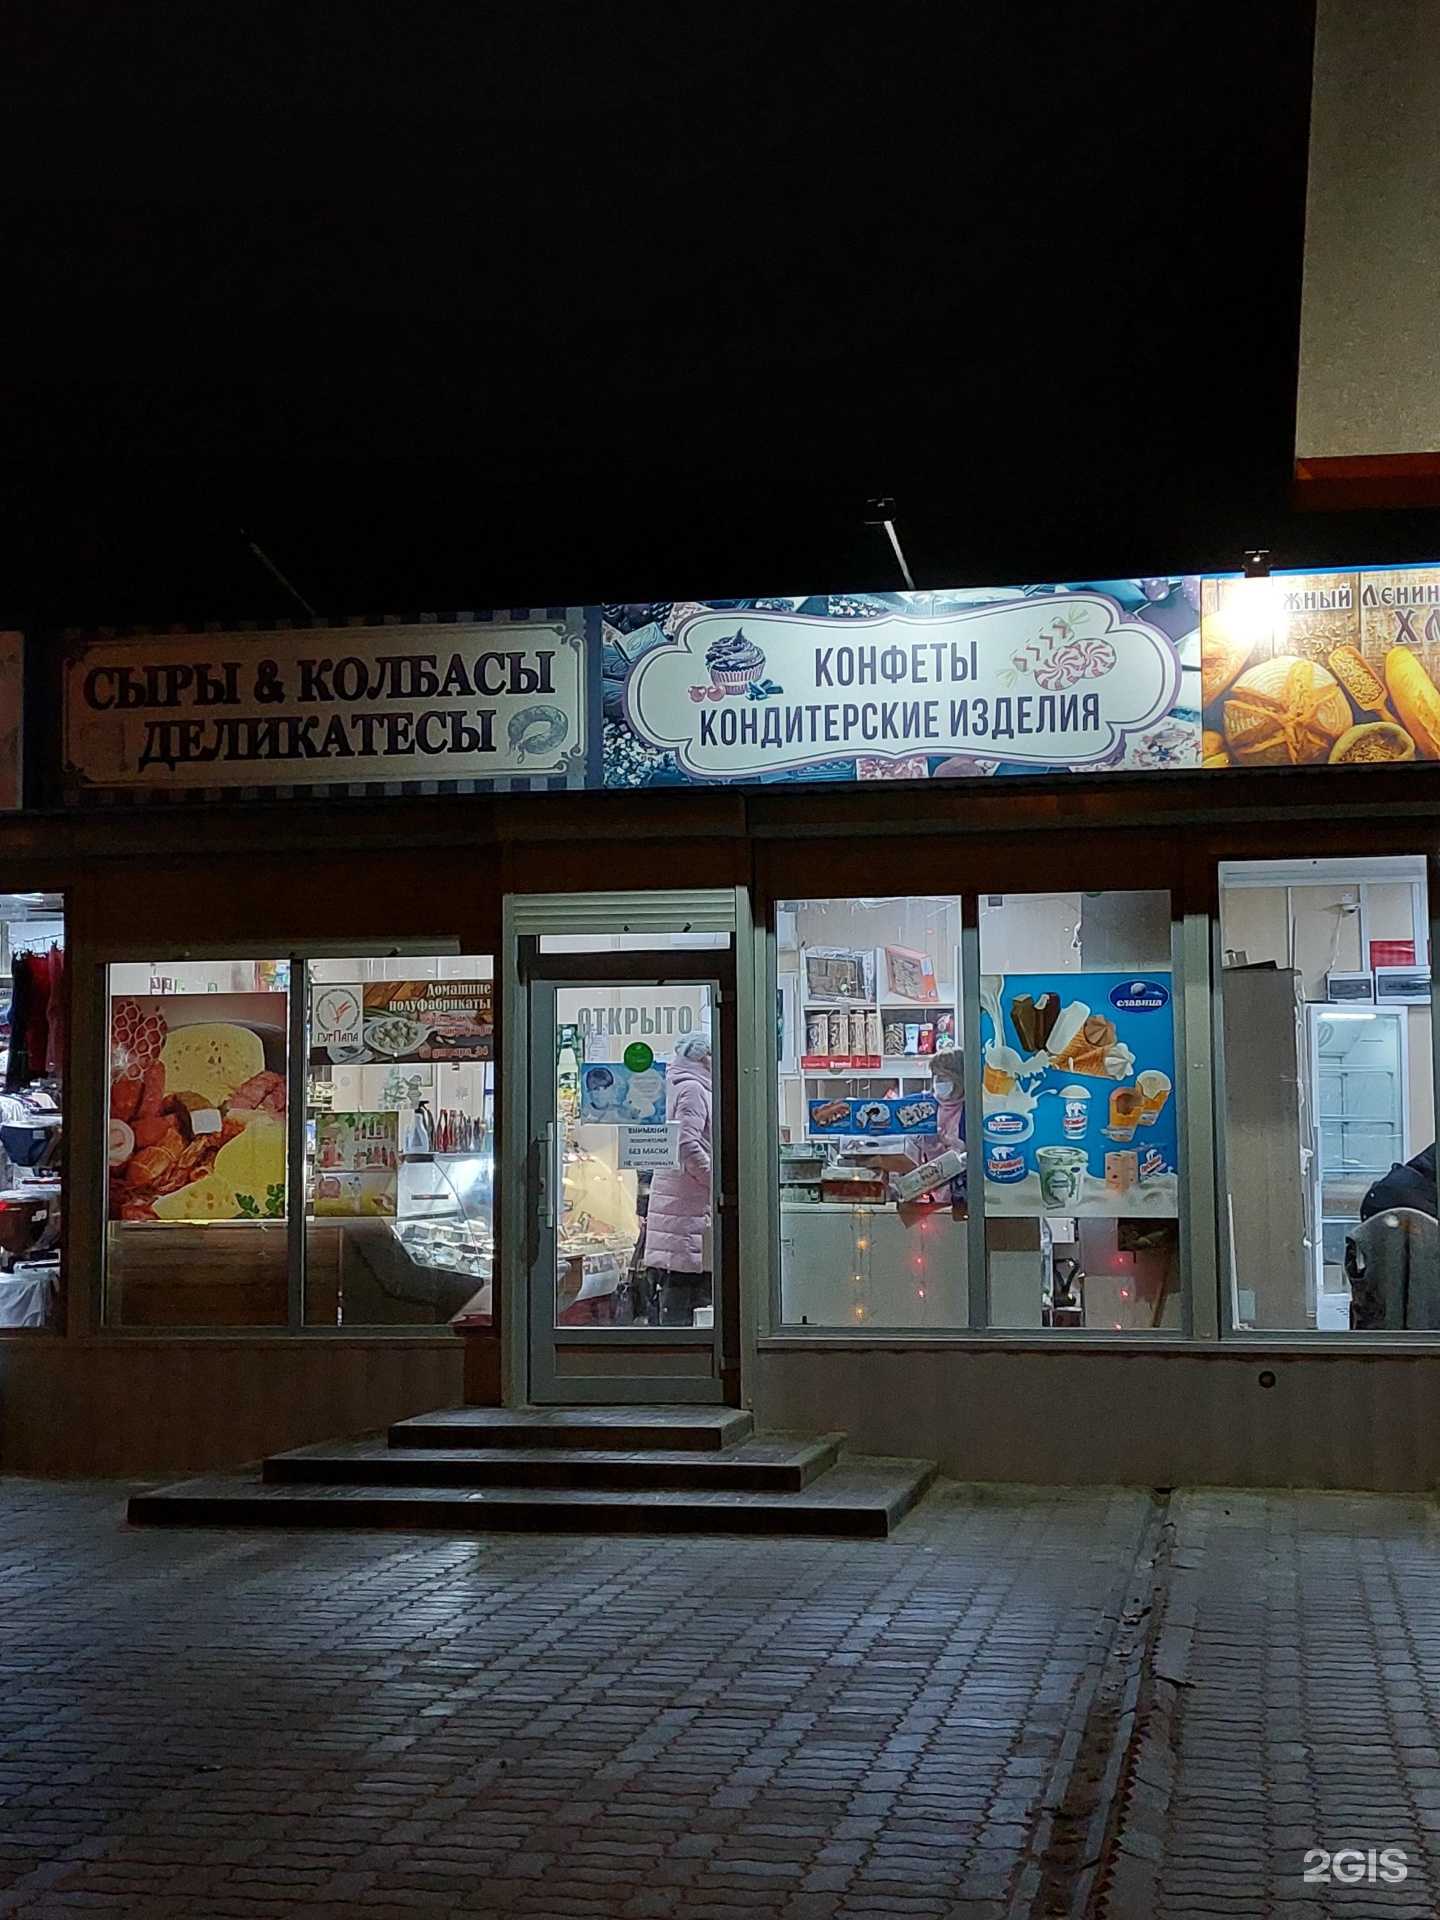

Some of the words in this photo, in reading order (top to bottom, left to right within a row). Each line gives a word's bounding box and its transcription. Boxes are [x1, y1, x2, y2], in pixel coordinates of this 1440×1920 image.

[83, 659, 241, 711] СЫРЫ
[253, 659, 286, 704] &
[297, 650, 556, 703] КОЛБАСЫ
[815, 641, 978, 687] КОНФЕТЫ
[138, 709, 497, 773] ДЕЛИКАТЕСЫ
[700, 700, 939, 749] КОНДИТЕРСКИЕ
[950, 693, 1100, 740] ИЗДЕЛИЯ
[389, 998, 491, 1013] полуфабрикаты
[426, 984, 491, 997] Домашние
[577, 1006, 693, 1035] ОТКРЫТО
